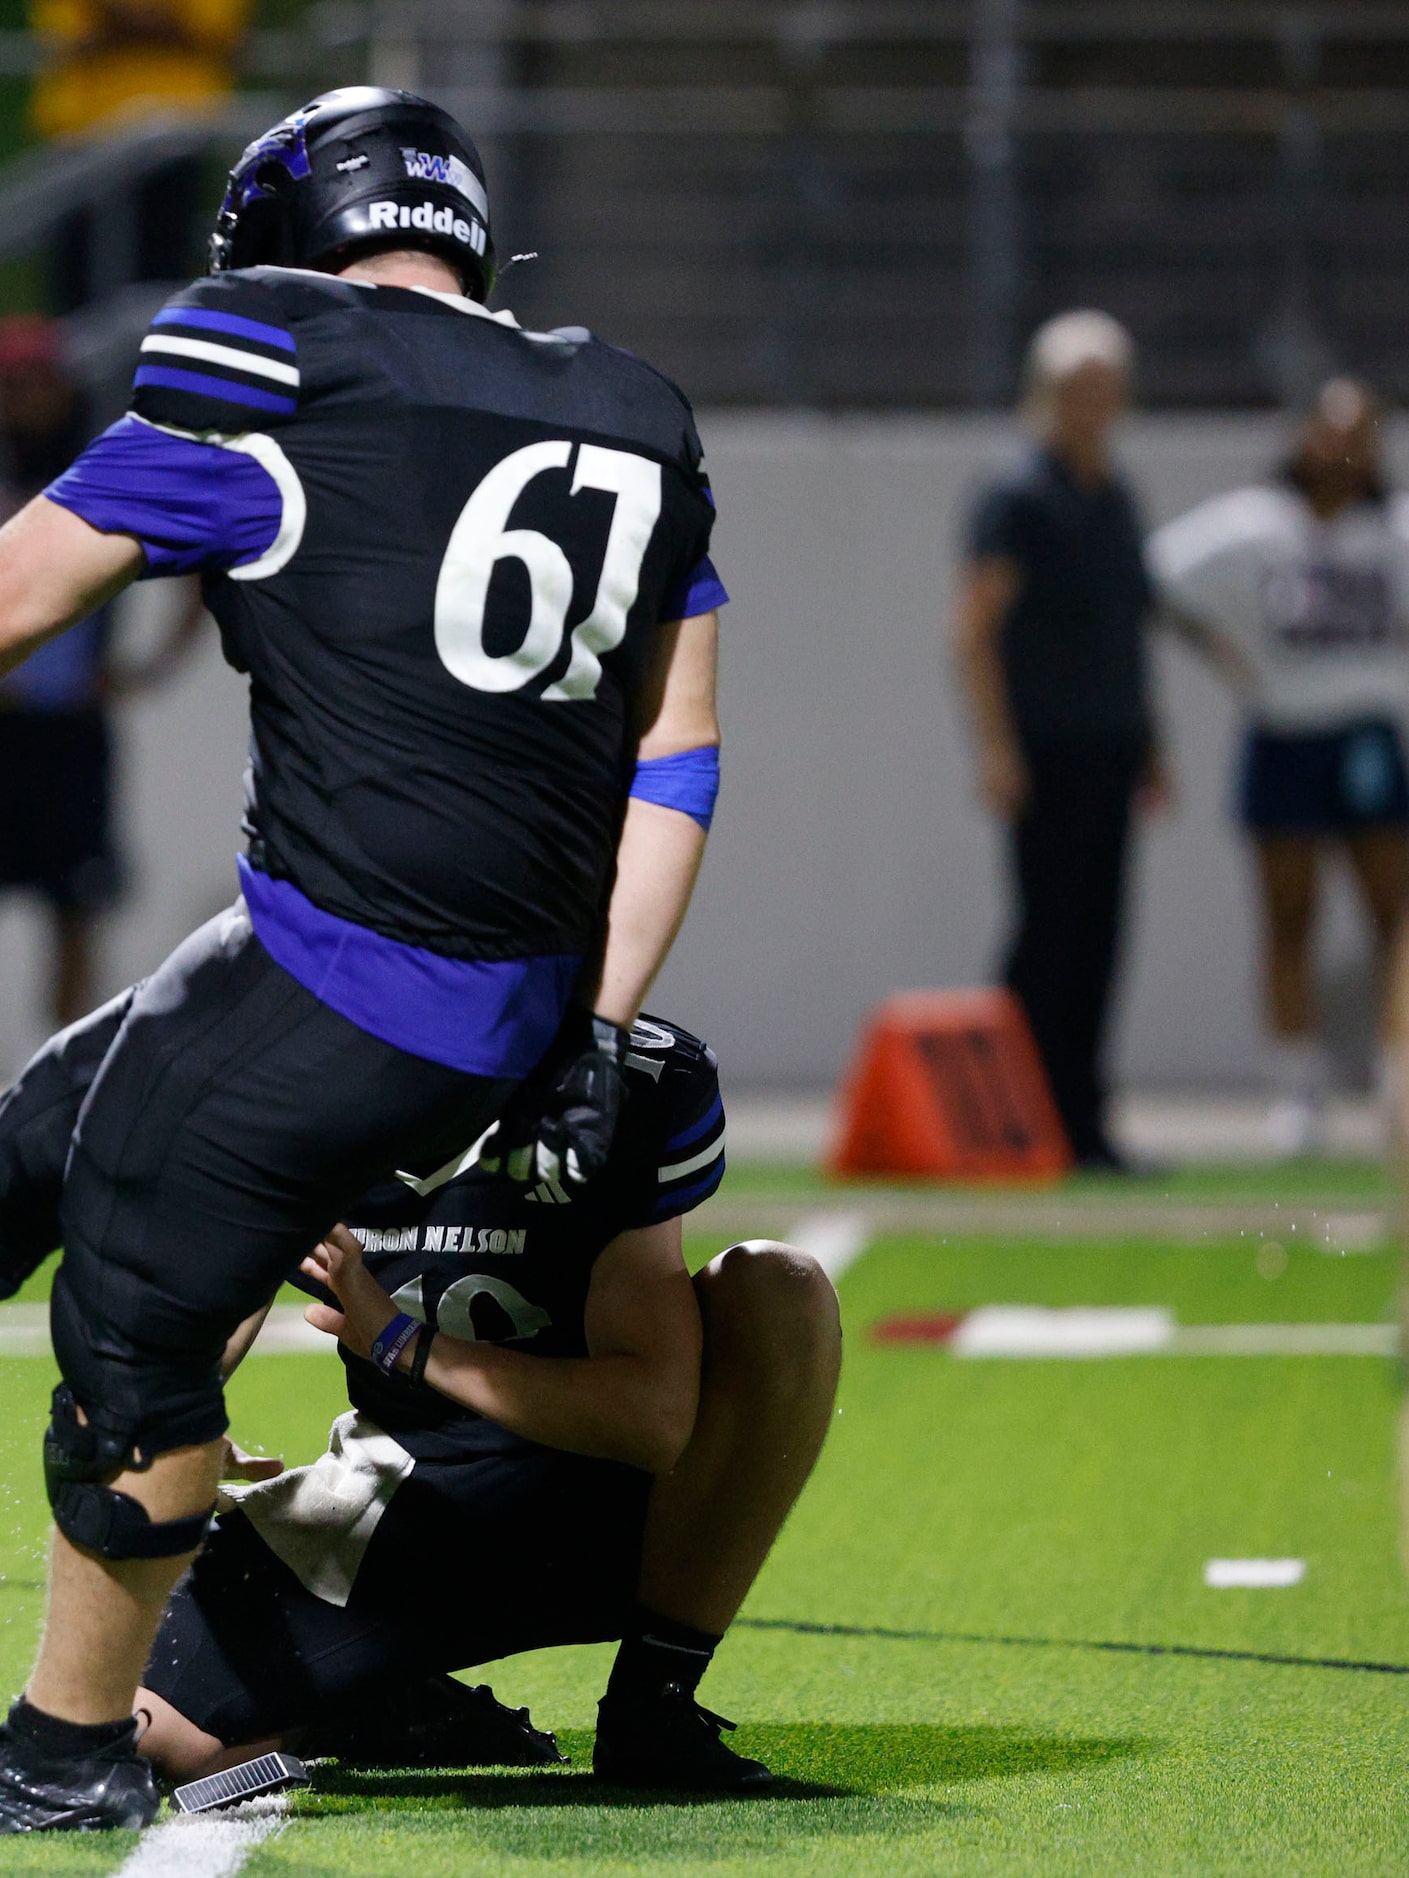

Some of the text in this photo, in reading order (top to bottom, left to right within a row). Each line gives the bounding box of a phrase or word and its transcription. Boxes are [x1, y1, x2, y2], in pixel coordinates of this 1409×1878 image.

[369, 200, 486, 257] Riddell
[434, 440, 662, 701] 67
[422, 1225, 527, 1254] NELSON
